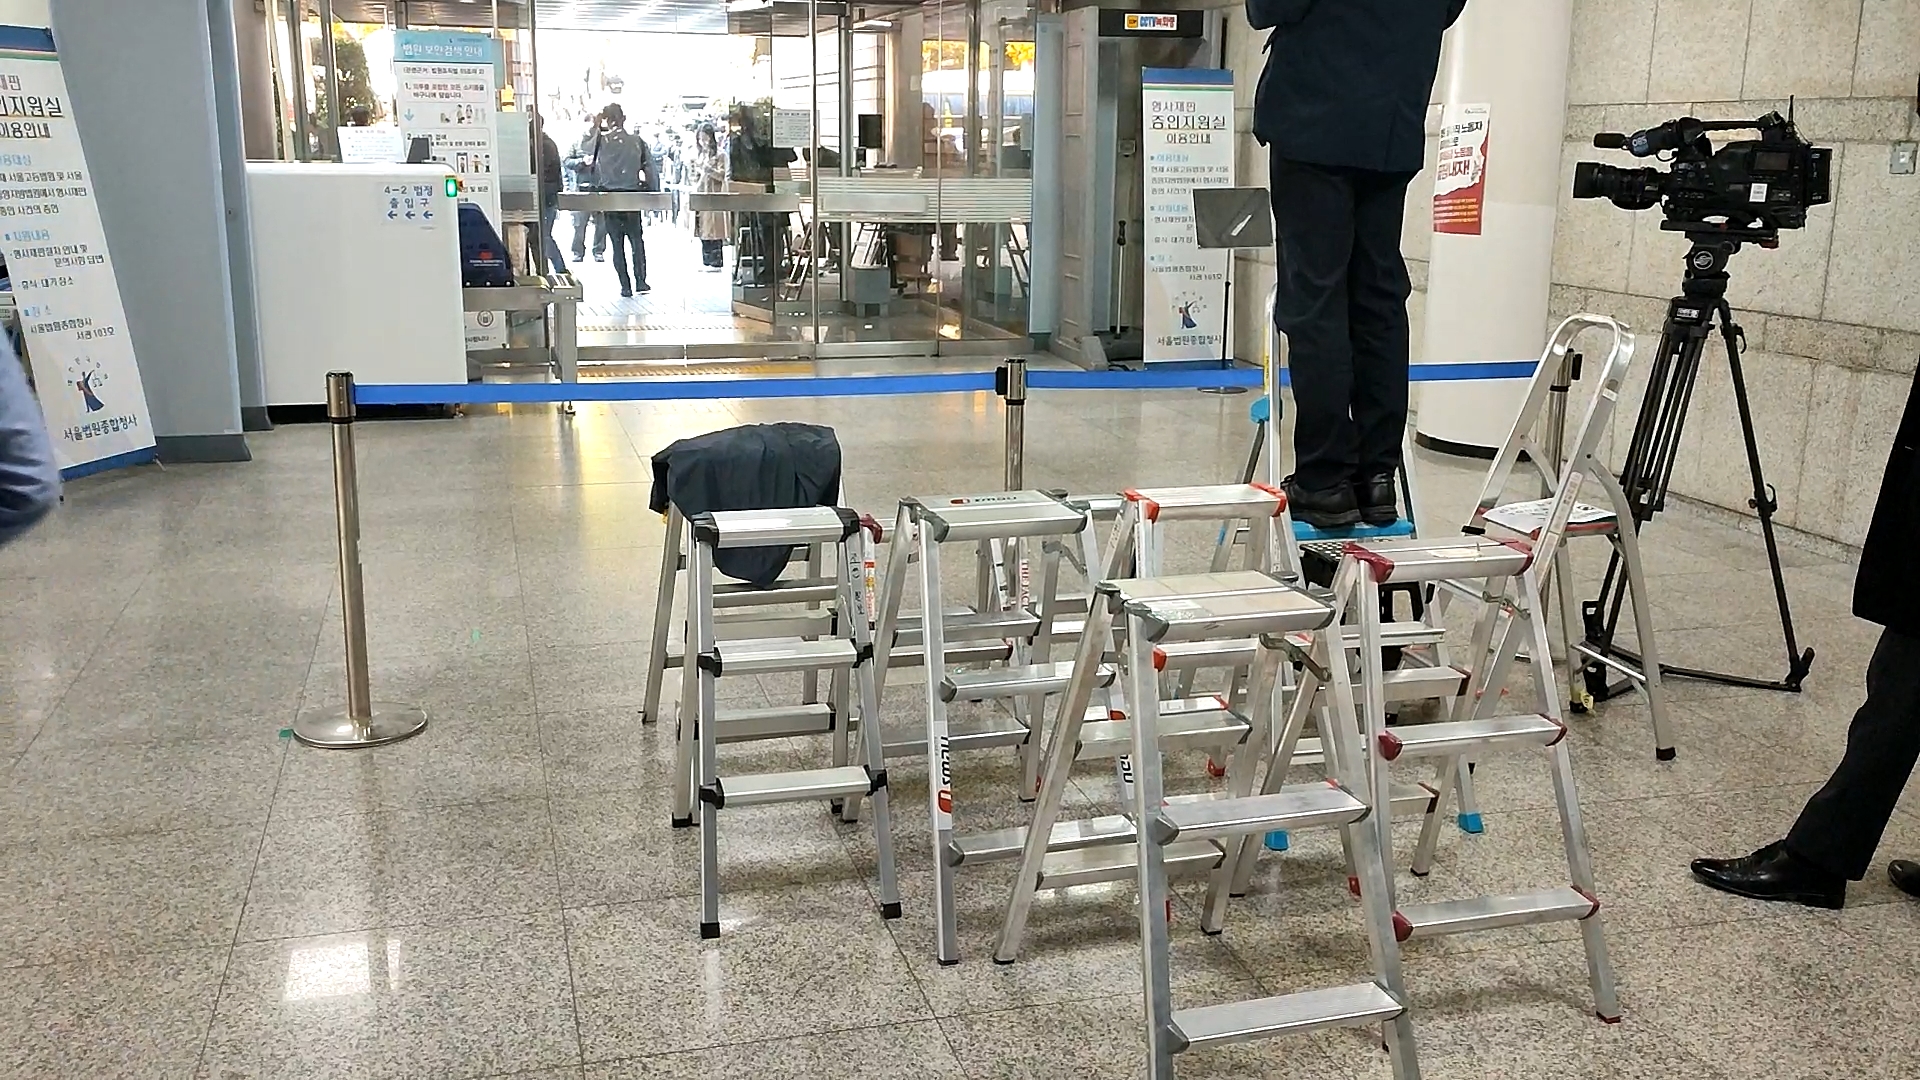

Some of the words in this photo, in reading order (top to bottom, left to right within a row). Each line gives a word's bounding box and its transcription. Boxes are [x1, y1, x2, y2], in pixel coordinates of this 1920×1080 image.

[402, 43, 422, 56] 법원
[425, 45, 463, 57] 보안검색
[464, 45, 483, 57] 안내
[1152, 114, 1227, 130] 증인지원실
[1166, 132, 1212, 145] 이용안내
[414, 185, 434, 196] 법정
[404, 198, 414, 209] 입
[420, 199, 430, 207] 구
[63, 413, 138, 442] 서울법원종합청사
